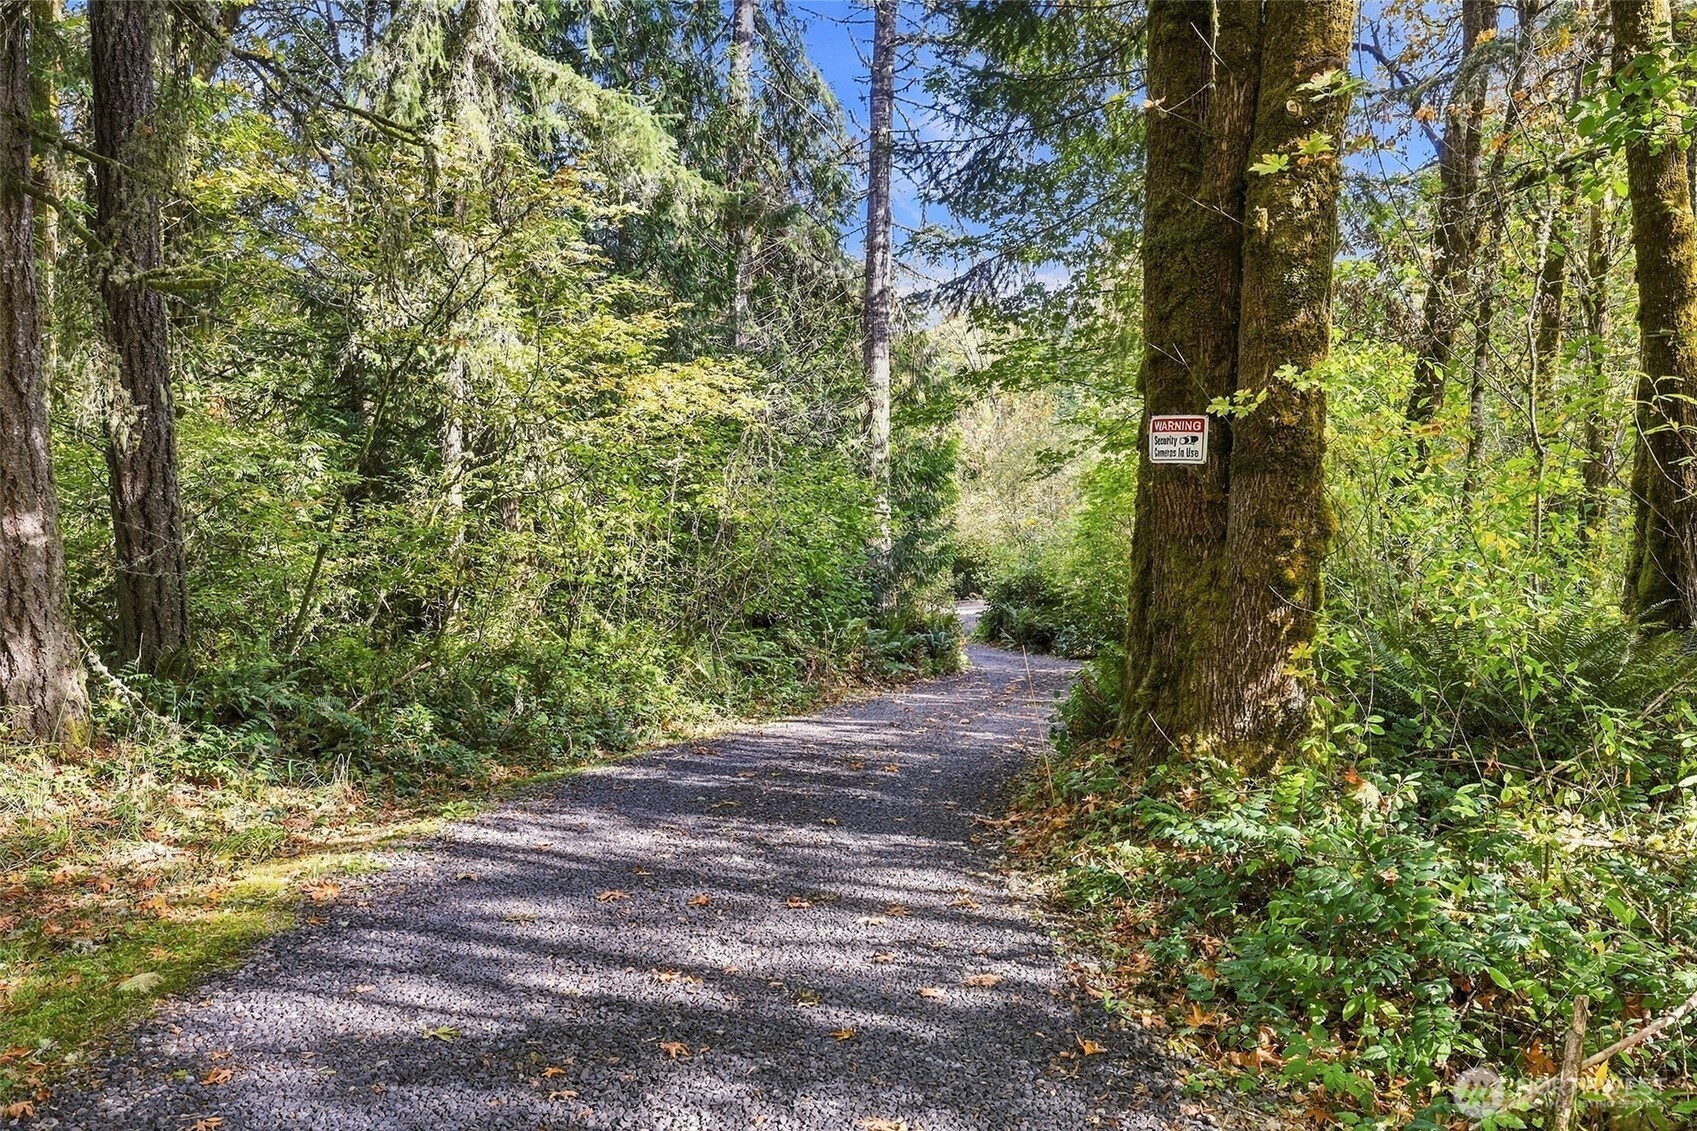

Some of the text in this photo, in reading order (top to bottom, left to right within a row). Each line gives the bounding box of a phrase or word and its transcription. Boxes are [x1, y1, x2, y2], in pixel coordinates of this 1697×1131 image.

[1154, 420, 1202, 431] WARNING
[1154, 435, 1178, 447] Security
[1154, 447, 1177, 458] Cameras
[1186, 447, 1199, 458] Use
